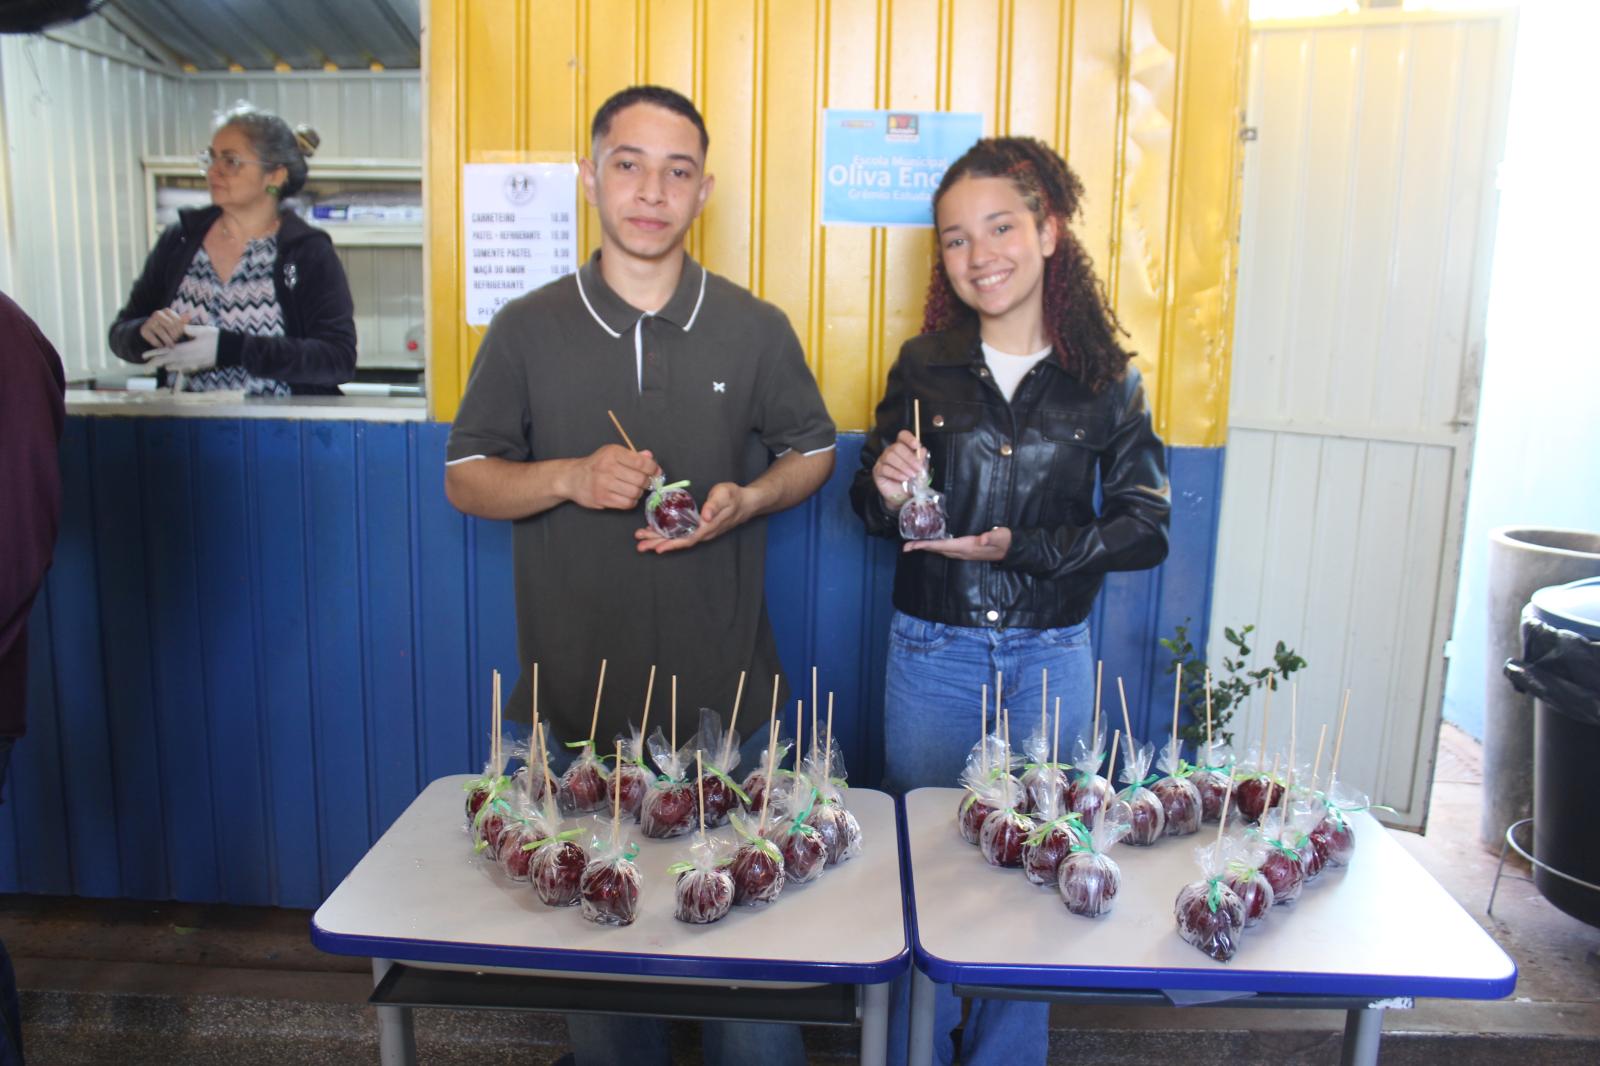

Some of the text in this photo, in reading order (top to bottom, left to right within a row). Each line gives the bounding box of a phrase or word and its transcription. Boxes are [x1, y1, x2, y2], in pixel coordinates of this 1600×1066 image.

[854, 155, 889, 166] Escola
[828, 164, 947, 188] Oliva Enc
[472, 213, 515, 222] CARRETEIRO
[473, 231, 492, 240] PASTEL
[500, 231, 540, 240] REFRIGERANTE
[474, 248, 504, 258] SOMENTE
[507, 248, 532, 258] PASTEL
[474, 264, 492, 275] MAÇÃ
[495, 265, 504, 274] DO
[506, 265, 525, 274] AMOR
[474, 280, 524, 289] REFRIGERANTE
